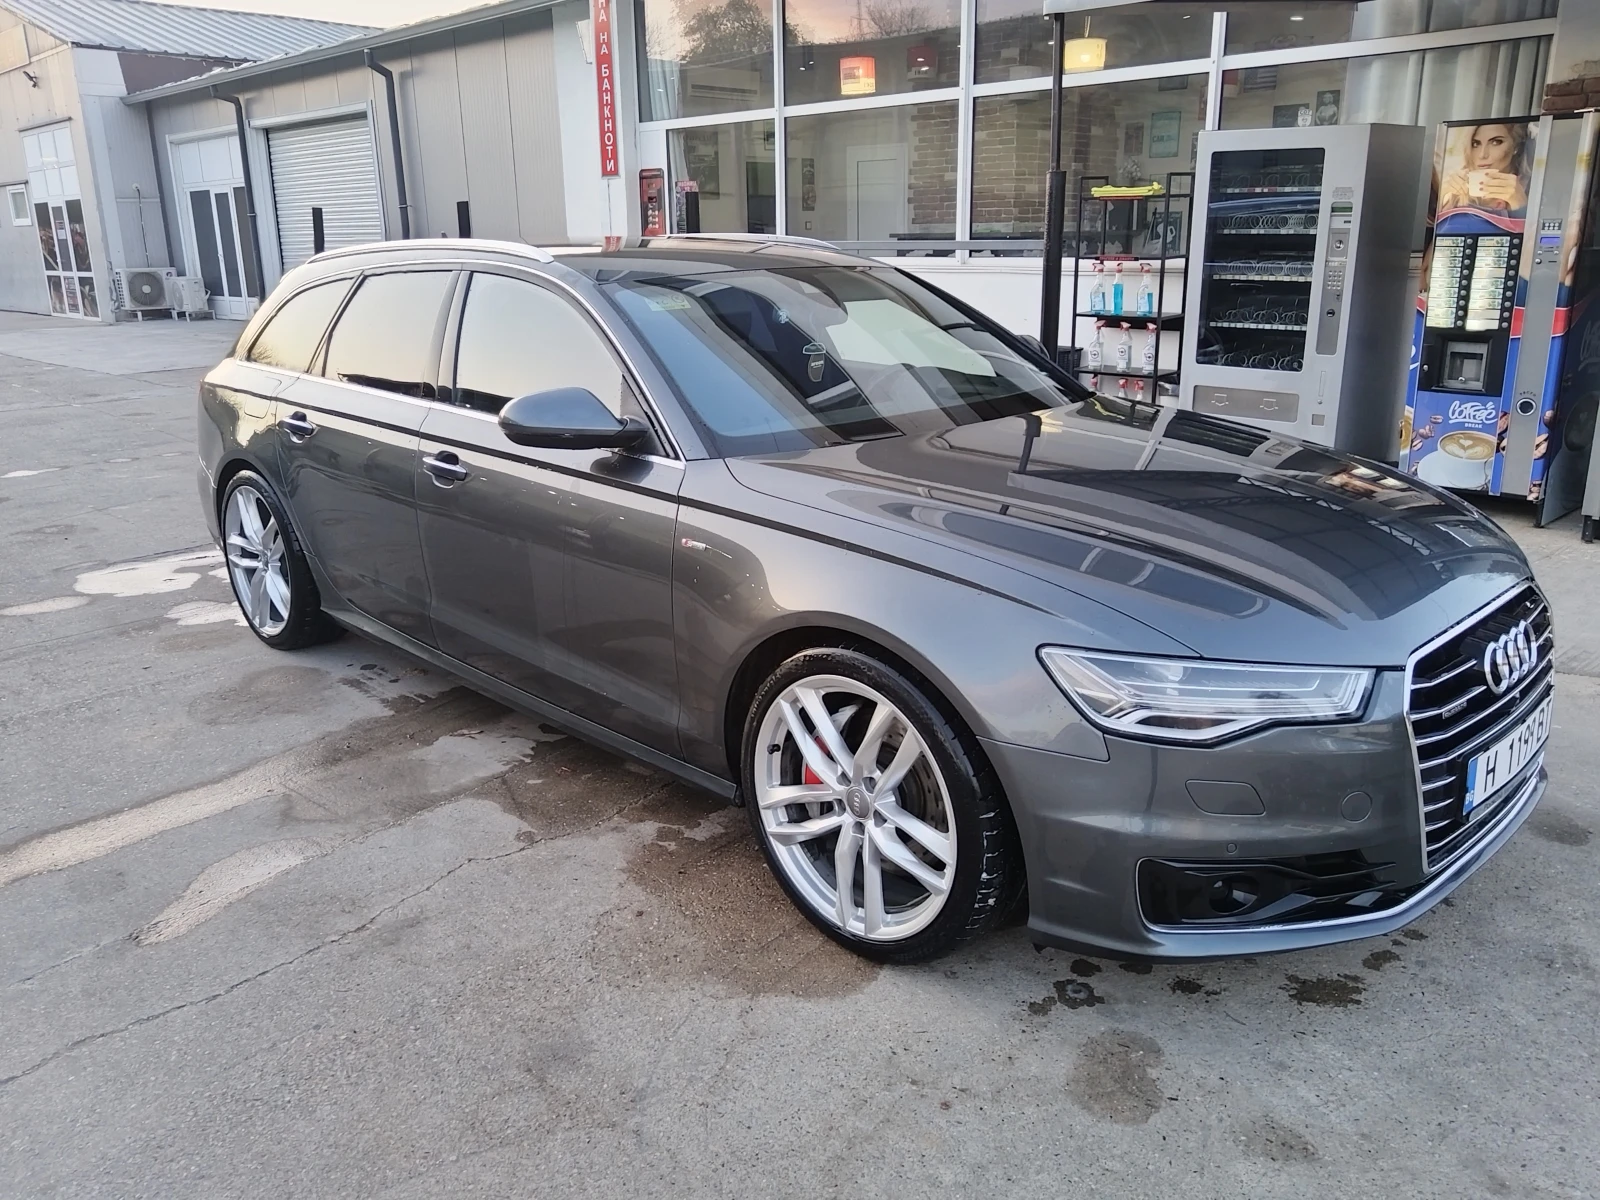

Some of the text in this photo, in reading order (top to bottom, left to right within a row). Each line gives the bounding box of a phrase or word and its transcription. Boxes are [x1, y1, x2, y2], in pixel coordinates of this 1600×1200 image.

[600, 32, 609, 55] НА
[601, 64, 615, 172] БАНКНОТИ
[1484, 751, 1498, 793] H
[1466, 790, 1475, 805] BG
